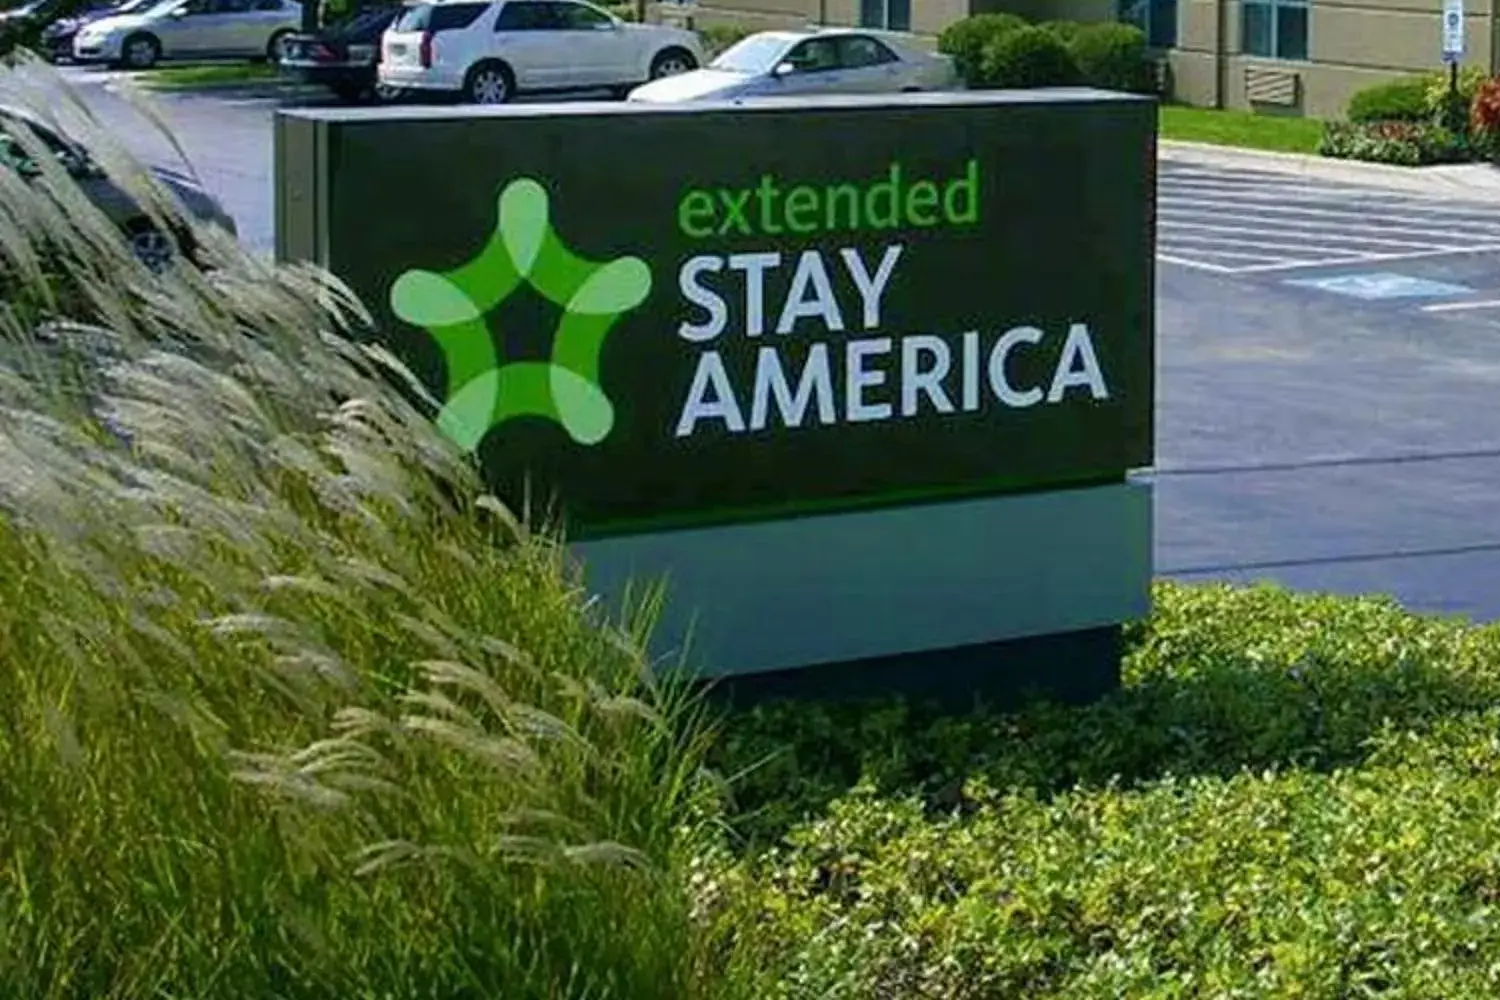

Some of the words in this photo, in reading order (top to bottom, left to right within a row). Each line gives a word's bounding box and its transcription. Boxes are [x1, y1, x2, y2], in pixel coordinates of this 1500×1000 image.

[678, 161, 980, 236] extended
[677, 245, 902, 341] STAY
[675, 323, 1109, 437] AMERICA
